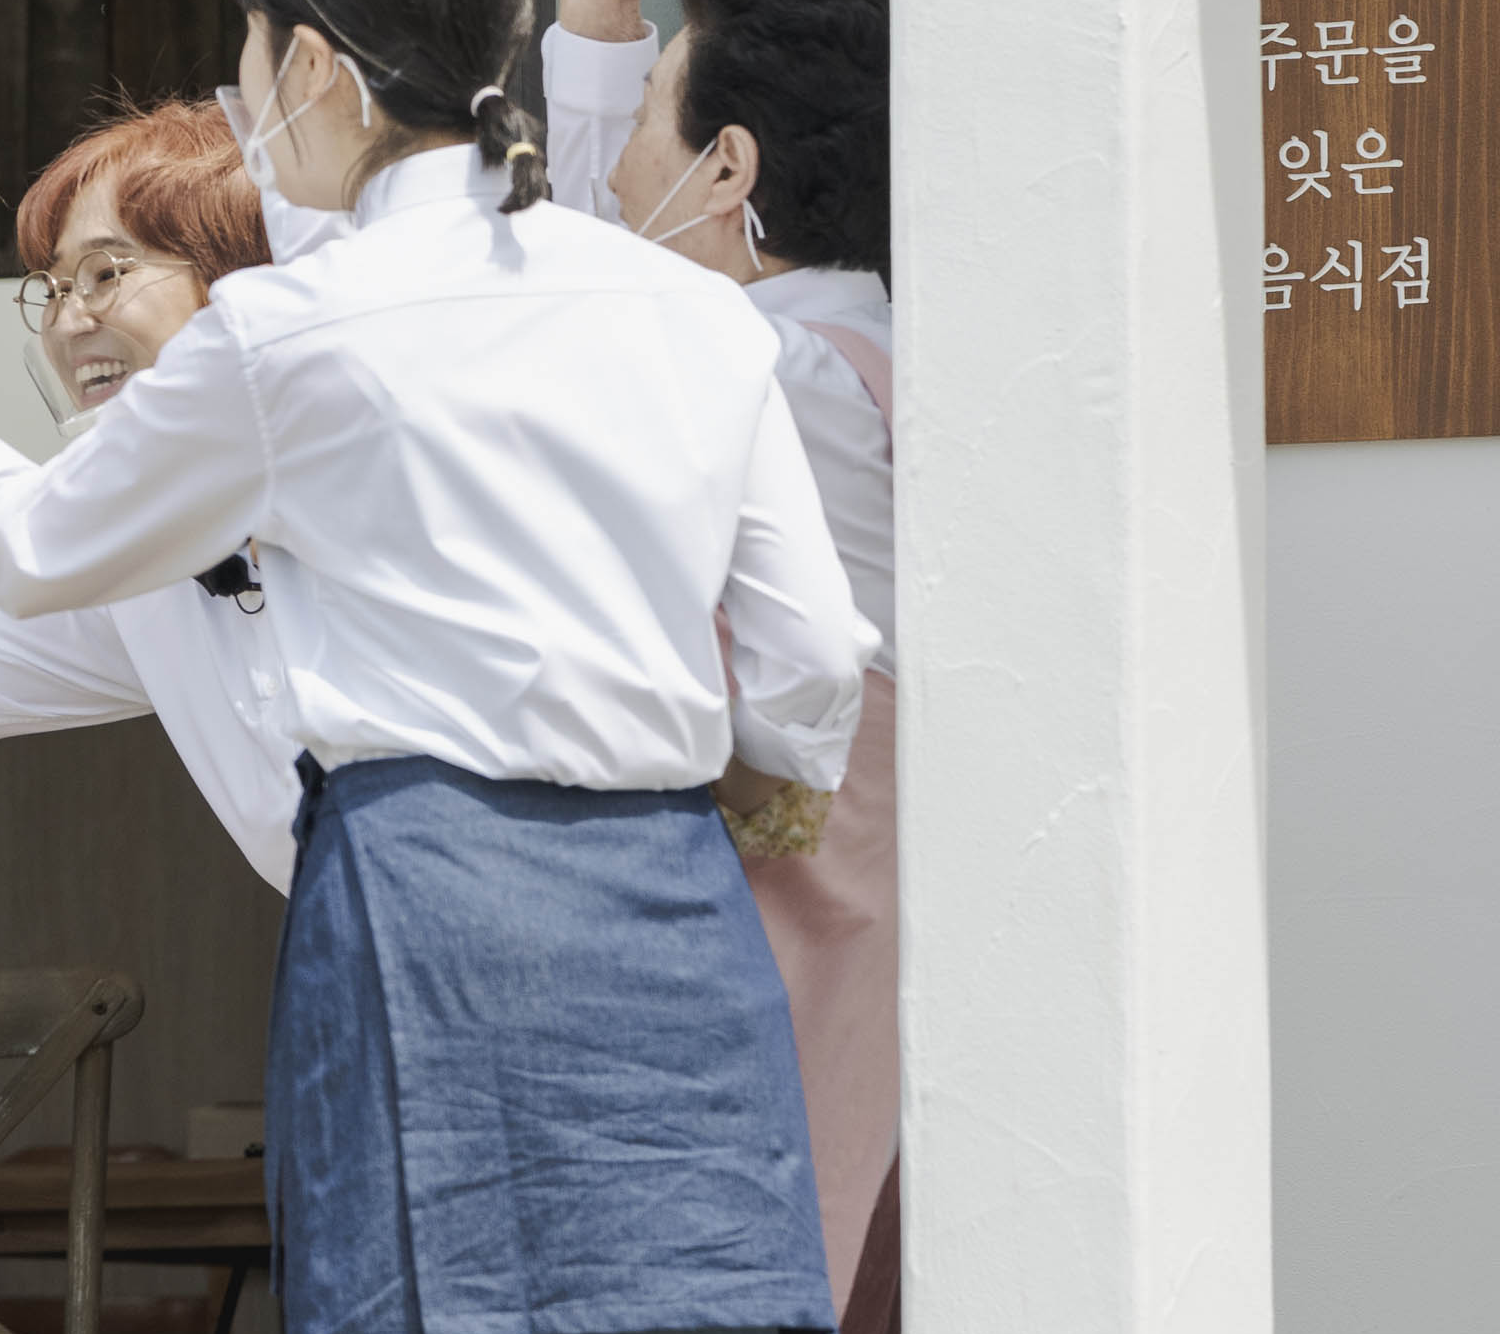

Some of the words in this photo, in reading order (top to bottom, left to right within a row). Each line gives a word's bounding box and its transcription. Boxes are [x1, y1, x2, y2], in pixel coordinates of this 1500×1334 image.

[1260, 14, 1435, 91] 주문을
[1278, 127, 1404, 203] 잊은
[1262, 236, 1430, 313] 음식점
